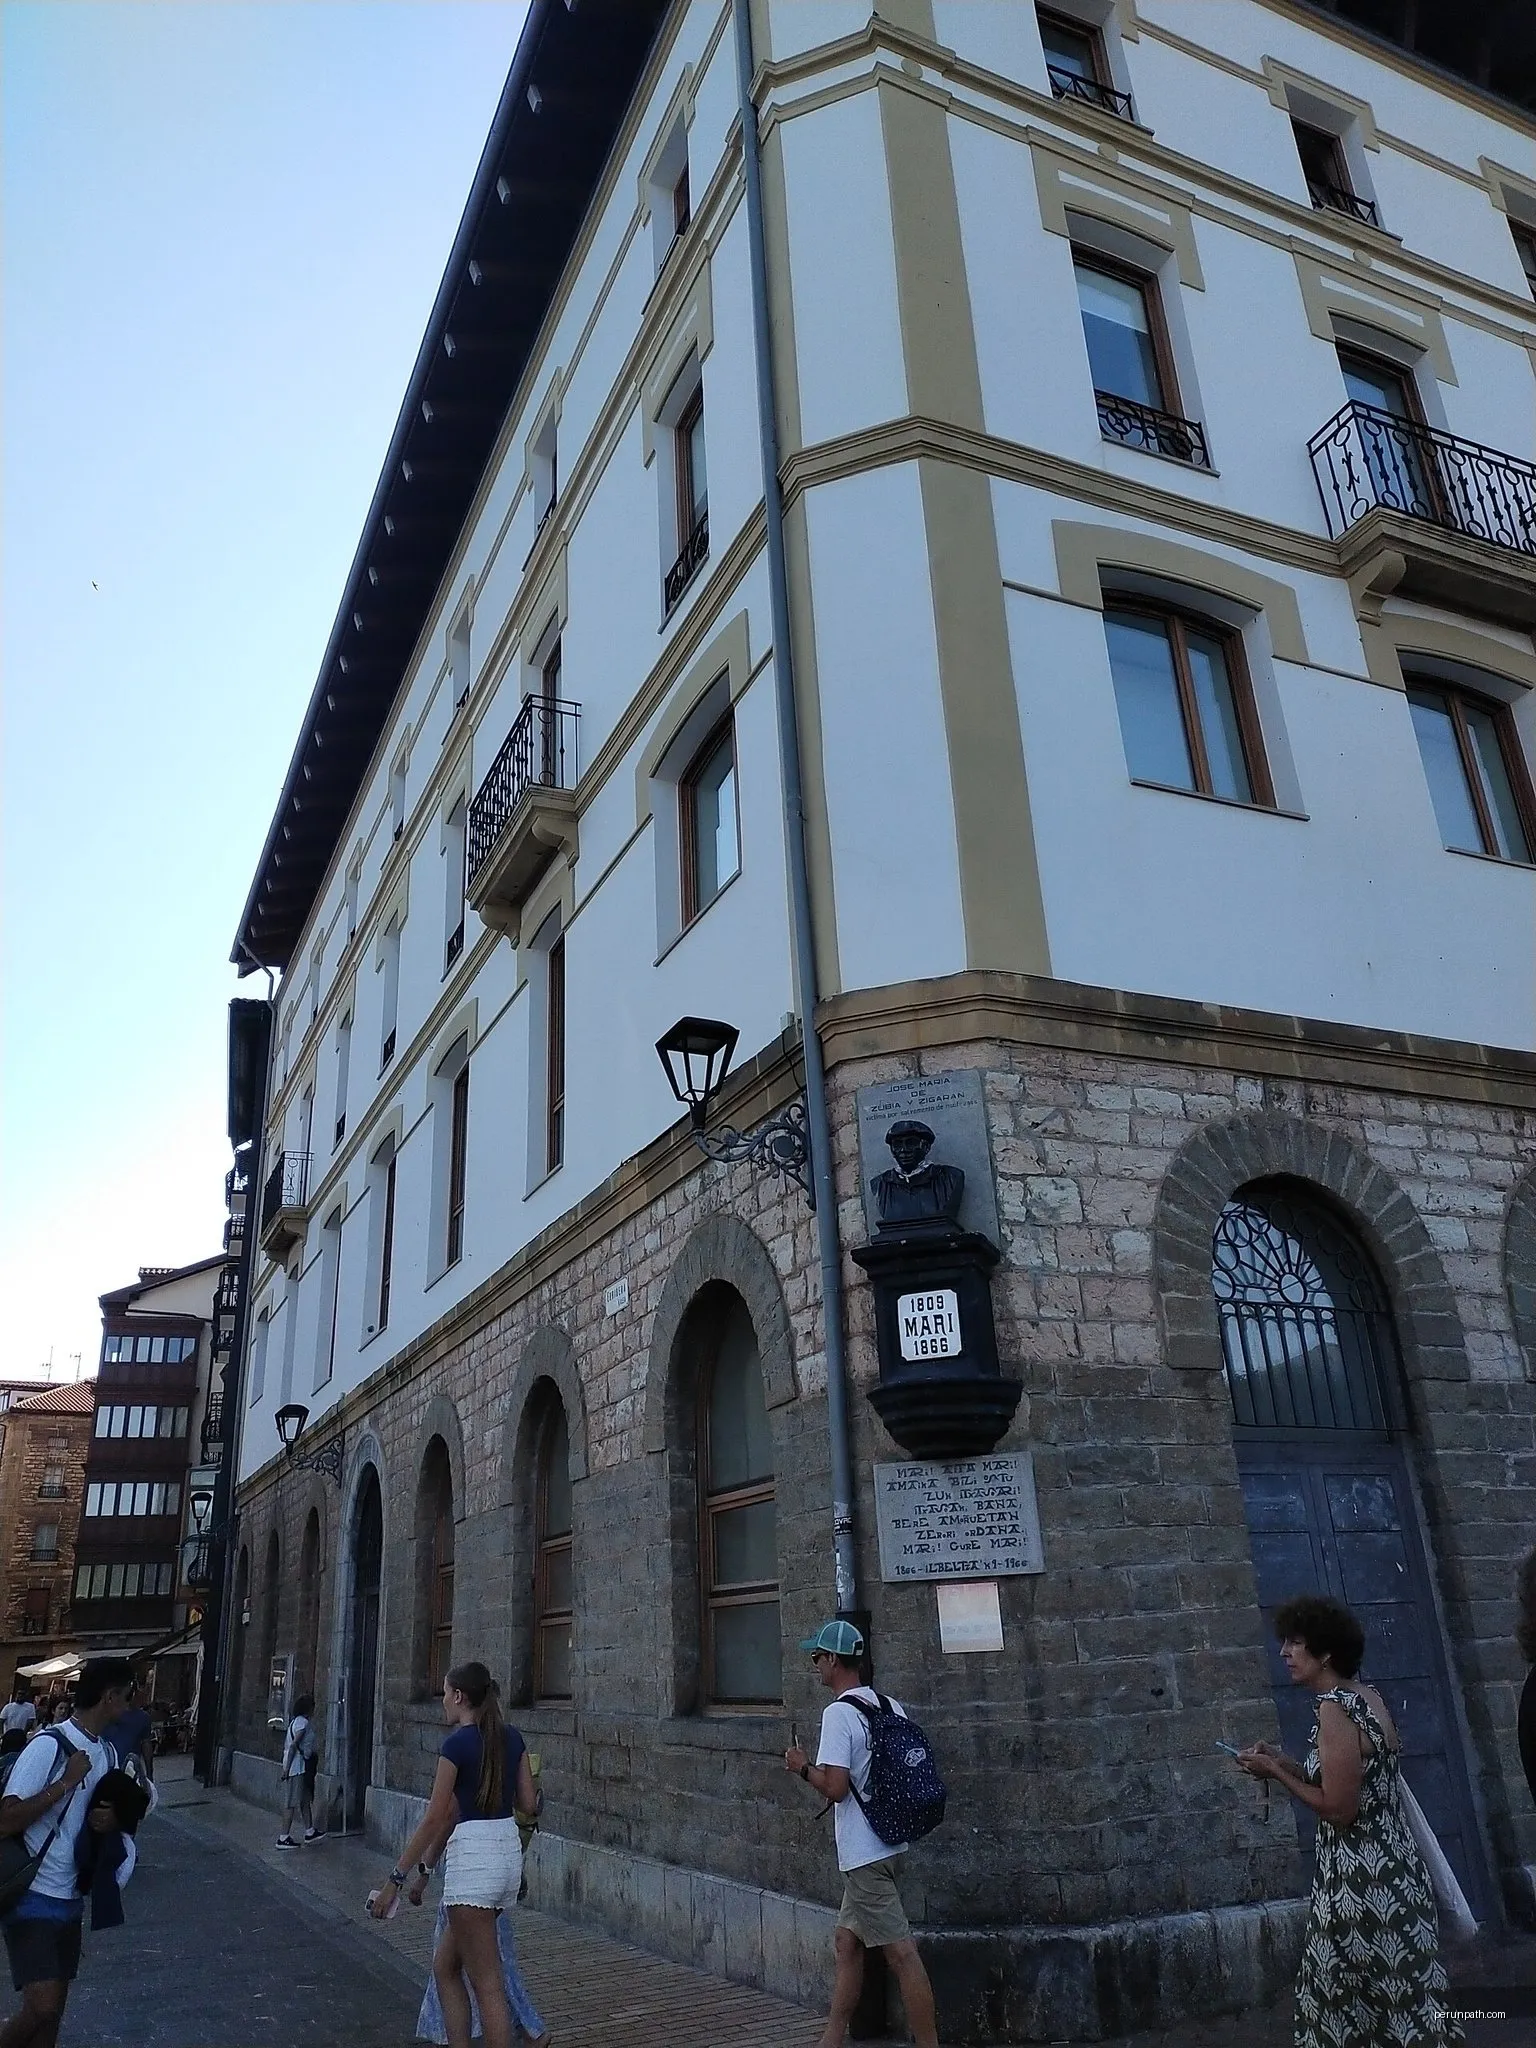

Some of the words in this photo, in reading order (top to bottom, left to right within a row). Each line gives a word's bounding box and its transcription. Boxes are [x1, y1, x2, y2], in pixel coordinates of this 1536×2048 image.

[886, 1083, 915, 1093] JOSE
[919, 1077, 951, 1088] MARIA
[911, 1089, 927, 1098] DE
[871, 1102, 901, 1112] ZUBIA
[918, 1092, 965, 1106] ZIGARAN
[910, 1295, 944, 1313] 1809
[904, 1313, 954, 1338] MARI
[914, 1337, 949, 1356] 1866
[891, 1517, 930, 1529] BERE
